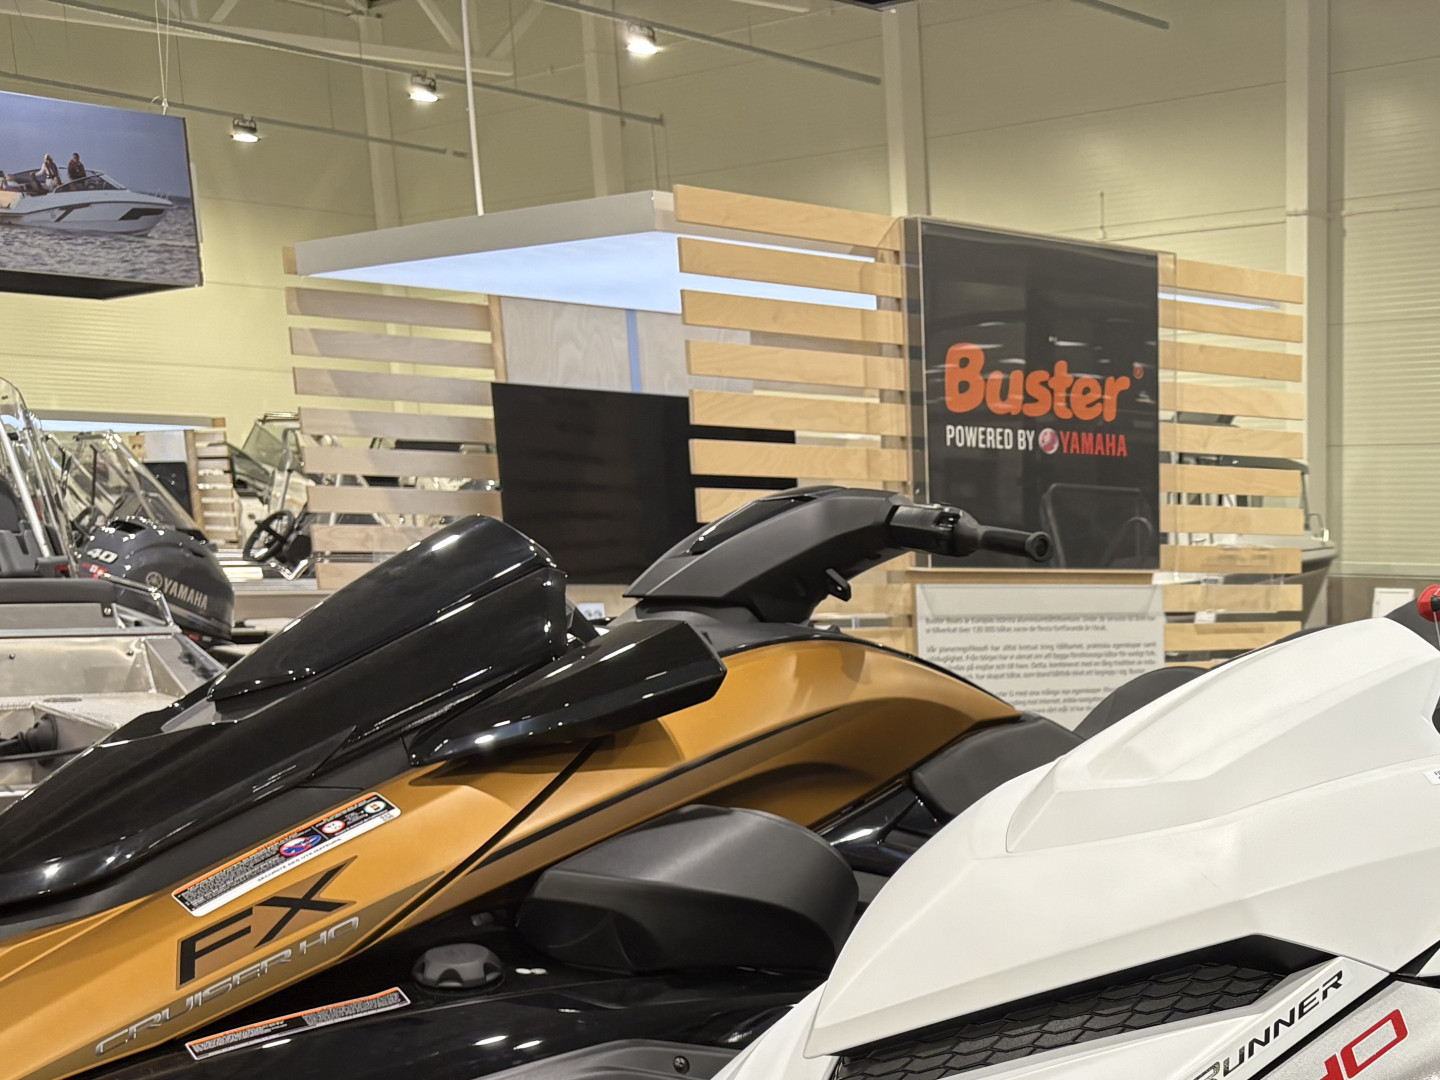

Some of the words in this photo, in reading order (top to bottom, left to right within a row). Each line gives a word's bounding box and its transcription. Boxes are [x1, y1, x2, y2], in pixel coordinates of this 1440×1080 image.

[945, 342, 1131, 422] Buster
[946, 425, 1013, 450] POWERED
[1018, 430, 1035, 451] BY
[1060, 431, 1128, 457] YAMAHA
[163, 577, 208, 610] YAMAHA
[178, 857, 356, 989] FX
[95, 949, 292, 1056] CRUISER
[300, 916, 359, 954] HO
